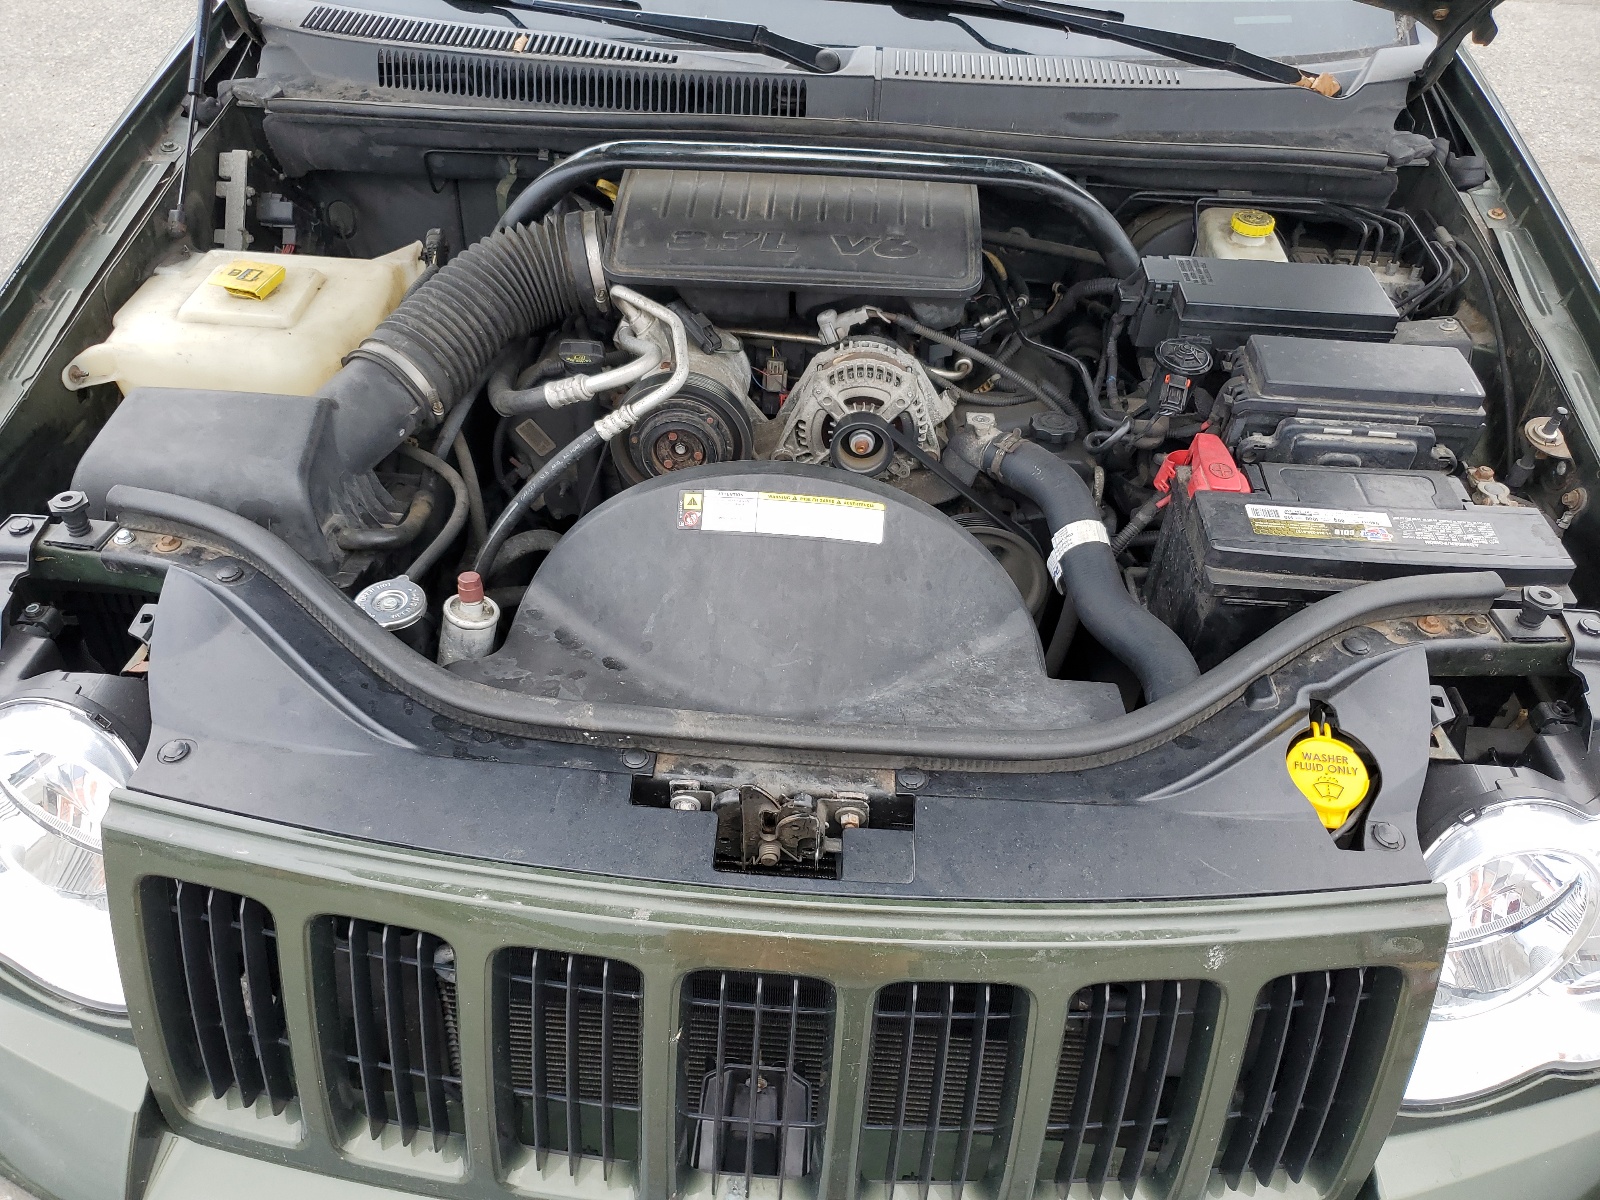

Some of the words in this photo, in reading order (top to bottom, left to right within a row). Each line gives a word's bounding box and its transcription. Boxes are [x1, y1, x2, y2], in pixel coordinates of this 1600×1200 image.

[666, 230, 799, 254] 3.7L
[830, 233, 921, 260] V6
[1302, 752, 1348, 764] WASHER
[1294, 761, 1324, 772] FLUID
[1327, 764, 1358, 776] ONLY
